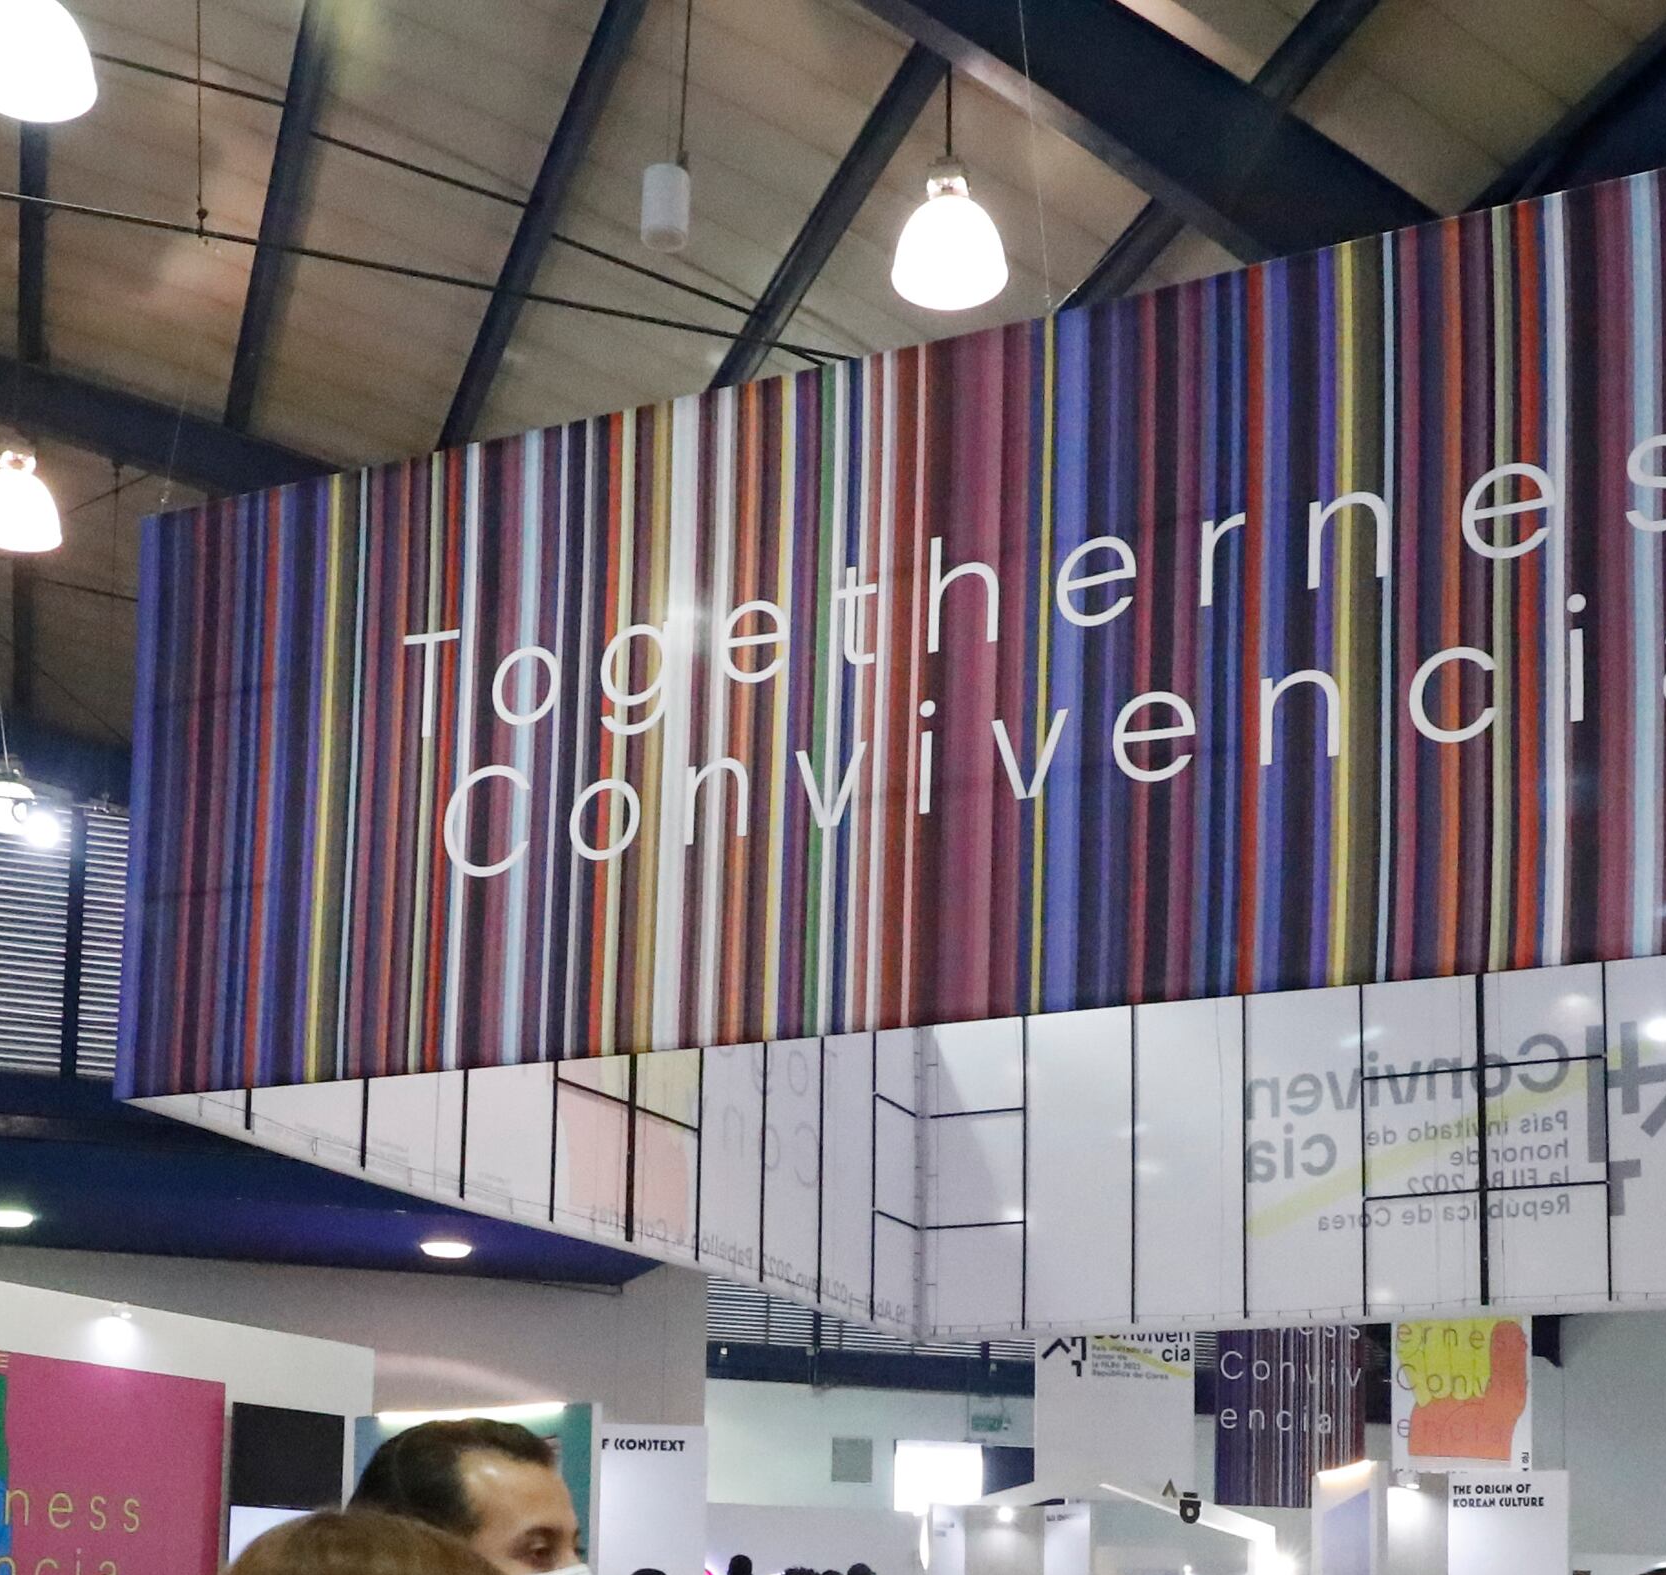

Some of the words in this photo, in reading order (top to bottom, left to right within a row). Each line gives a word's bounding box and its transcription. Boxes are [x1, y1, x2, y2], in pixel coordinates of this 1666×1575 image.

[1161, 1345, 1191, 1363] cia
[1220, 1350, 1362, 1388] Conviv
[1220, 1407, 1332, 1435] encia
[1452, 1485, 1472, 1495] THE
[1474, 1484, 1513, 1495] ORIGIN
[1516, 1483, 1532, 1494] OF
[1452, 1498, 1496, 1509] KOREAN
[1498, 1496, 1545, 1508] CULTURE
